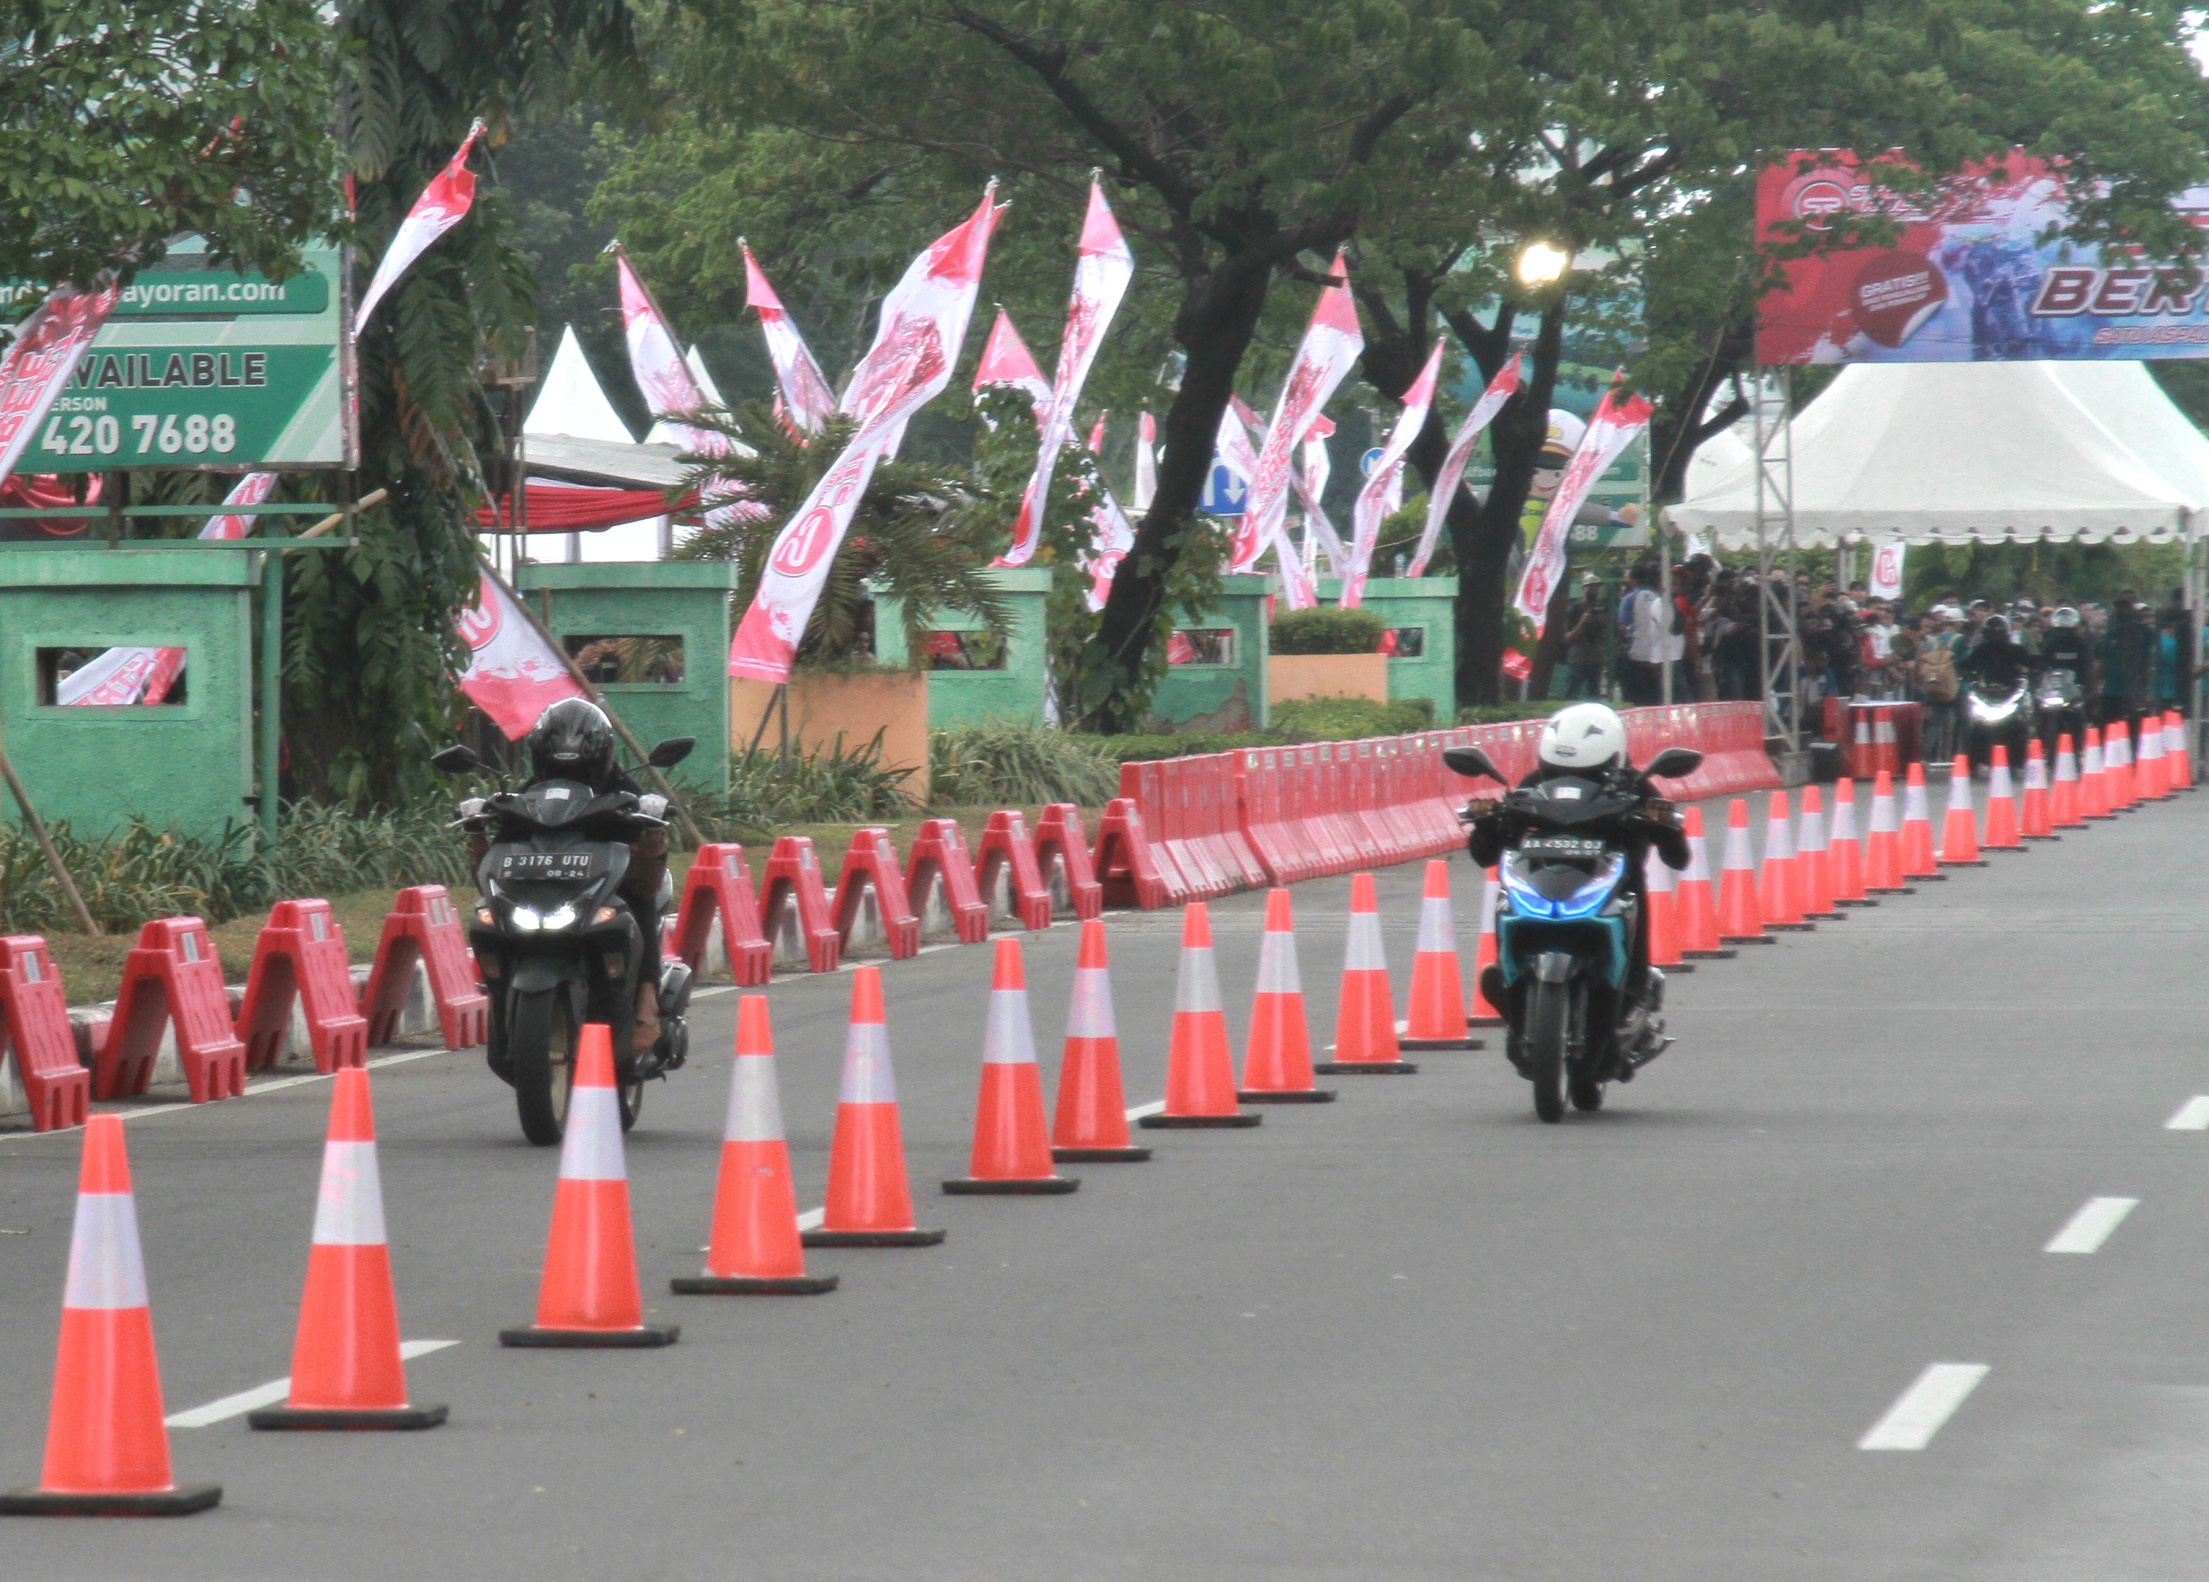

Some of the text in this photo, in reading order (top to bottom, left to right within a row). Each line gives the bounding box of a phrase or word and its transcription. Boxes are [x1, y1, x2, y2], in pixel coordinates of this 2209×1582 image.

[2031, 266, 2209, 315] BER
[66, 352, 268, 389] VAILABLE
[51, 396, 108, 412] ERSON
[42, 413, 237, 455] 420 7688
[503, 855, 589, 868] B 3176 UTU
